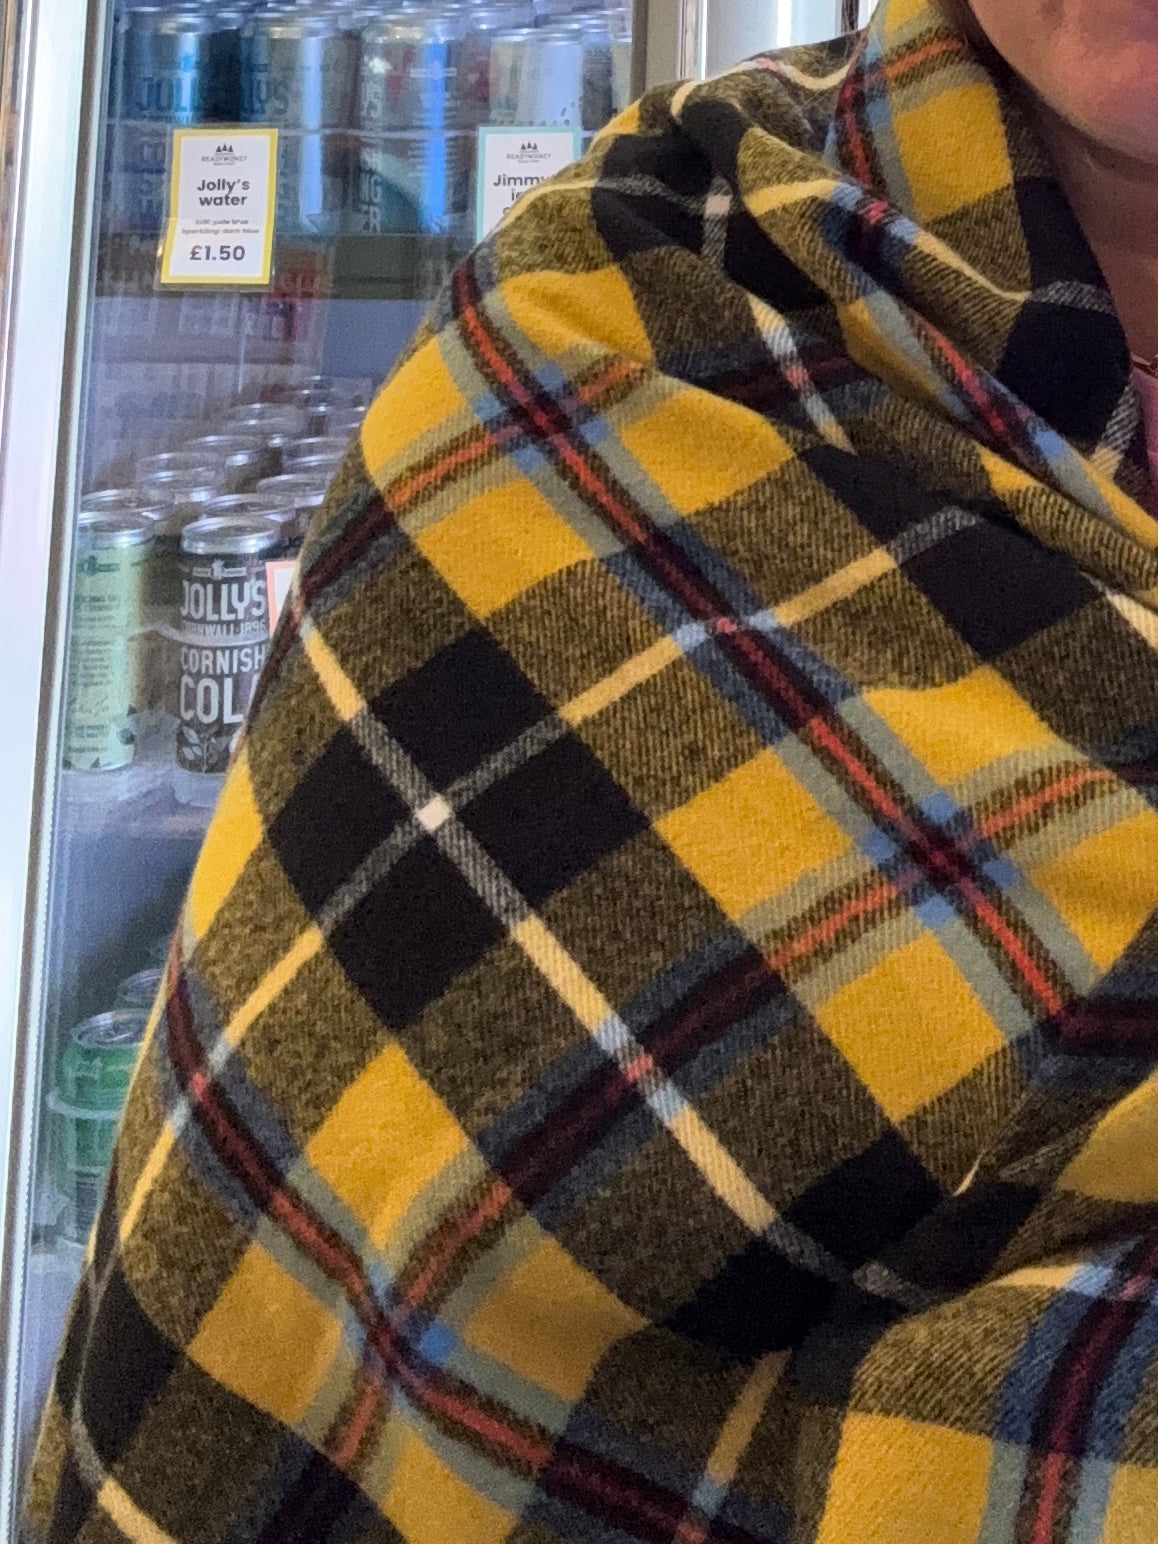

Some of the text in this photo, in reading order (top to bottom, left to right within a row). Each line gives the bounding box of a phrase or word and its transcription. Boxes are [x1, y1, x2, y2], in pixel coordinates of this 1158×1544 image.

[197, 178, 250, 195] Jolly's
[199, 194, 248, 206] water
[189, 245, 246, 261] £1.50
[180, 579, 267, 621] JOLLY'S
[180, 644, 266, 675] CORNISH
